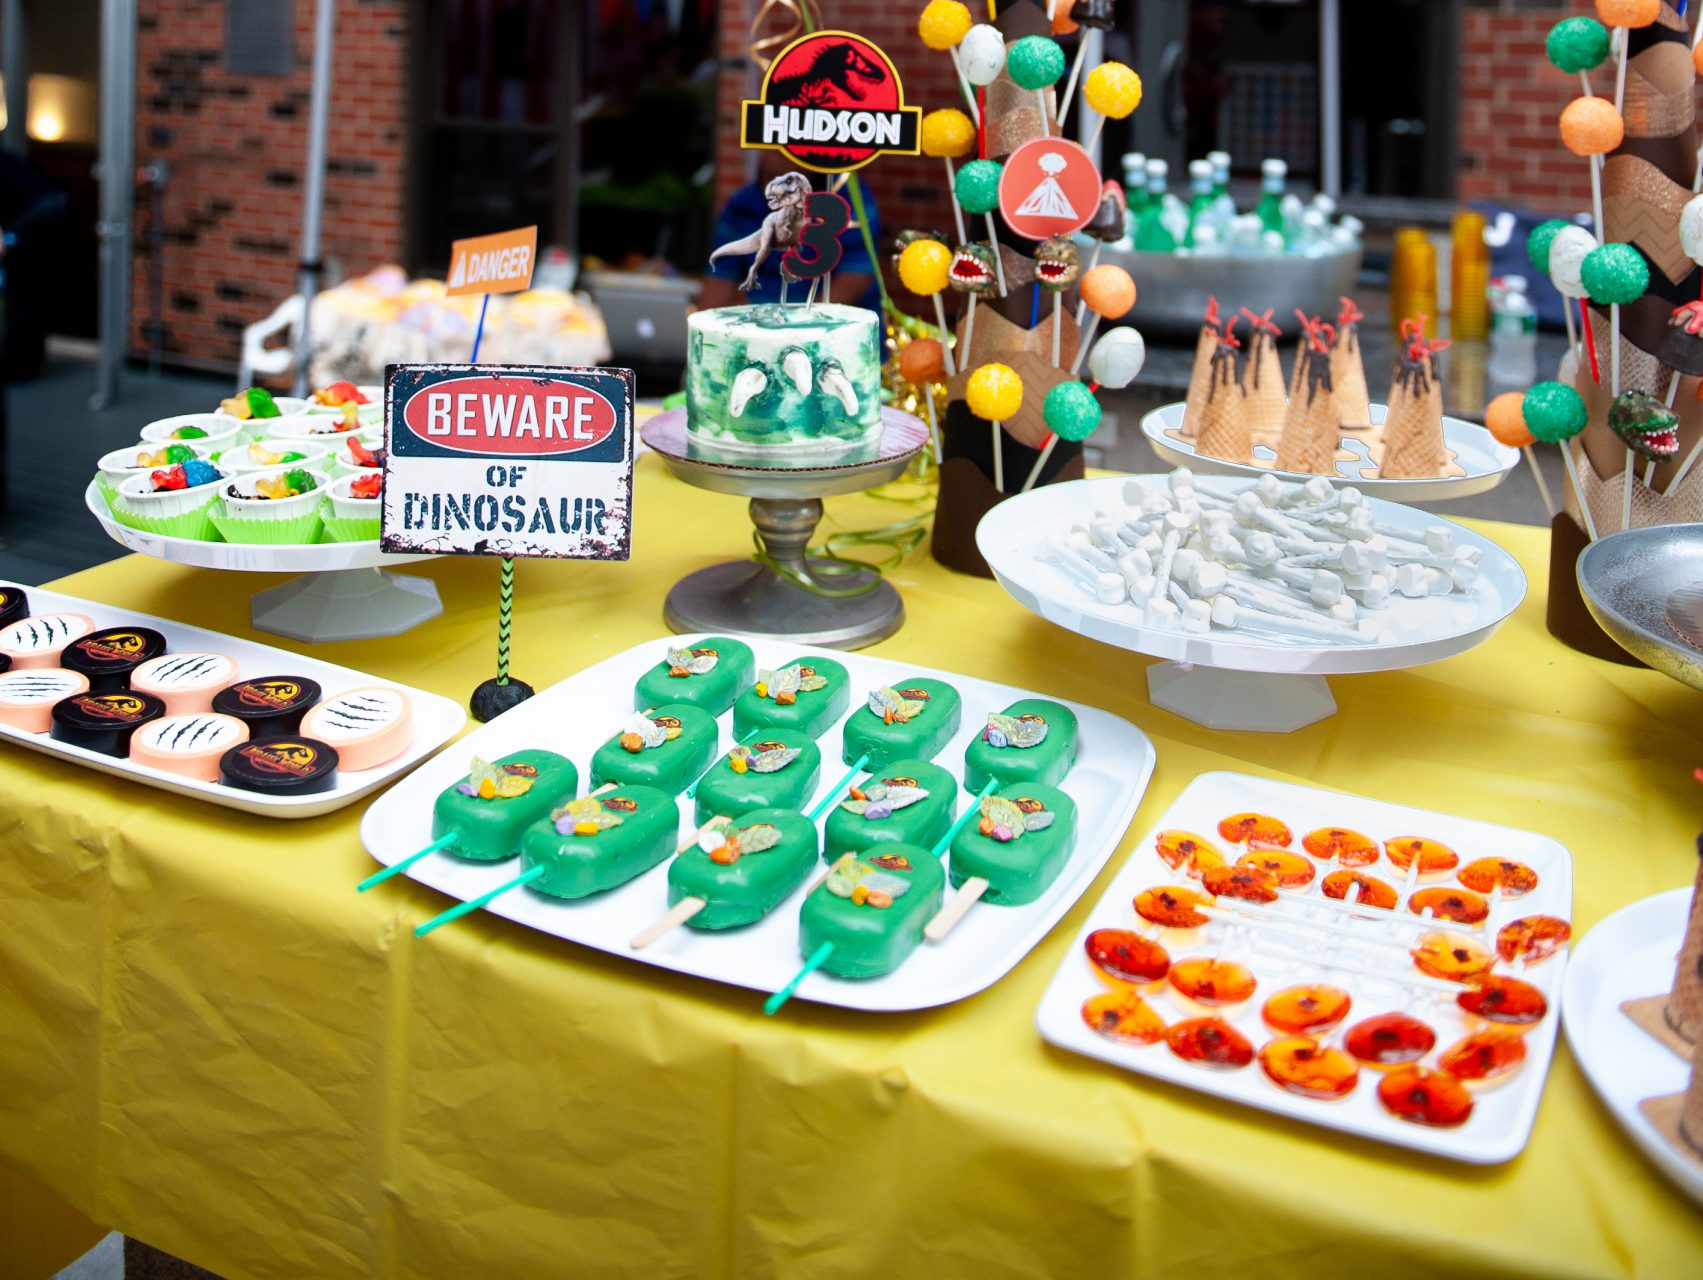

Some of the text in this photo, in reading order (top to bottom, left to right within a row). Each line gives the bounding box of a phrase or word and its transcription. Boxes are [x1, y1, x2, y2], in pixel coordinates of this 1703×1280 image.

[763, 104, 902, 145] HUDSON
[782, 191, 851, 280] 3
[468, 245, 531, 284] DANGER
[427, 393, 595, 440] BEWARE
[486, 465, 527, 488] OF
[403, 493, 607, 535] DINOSAUR
